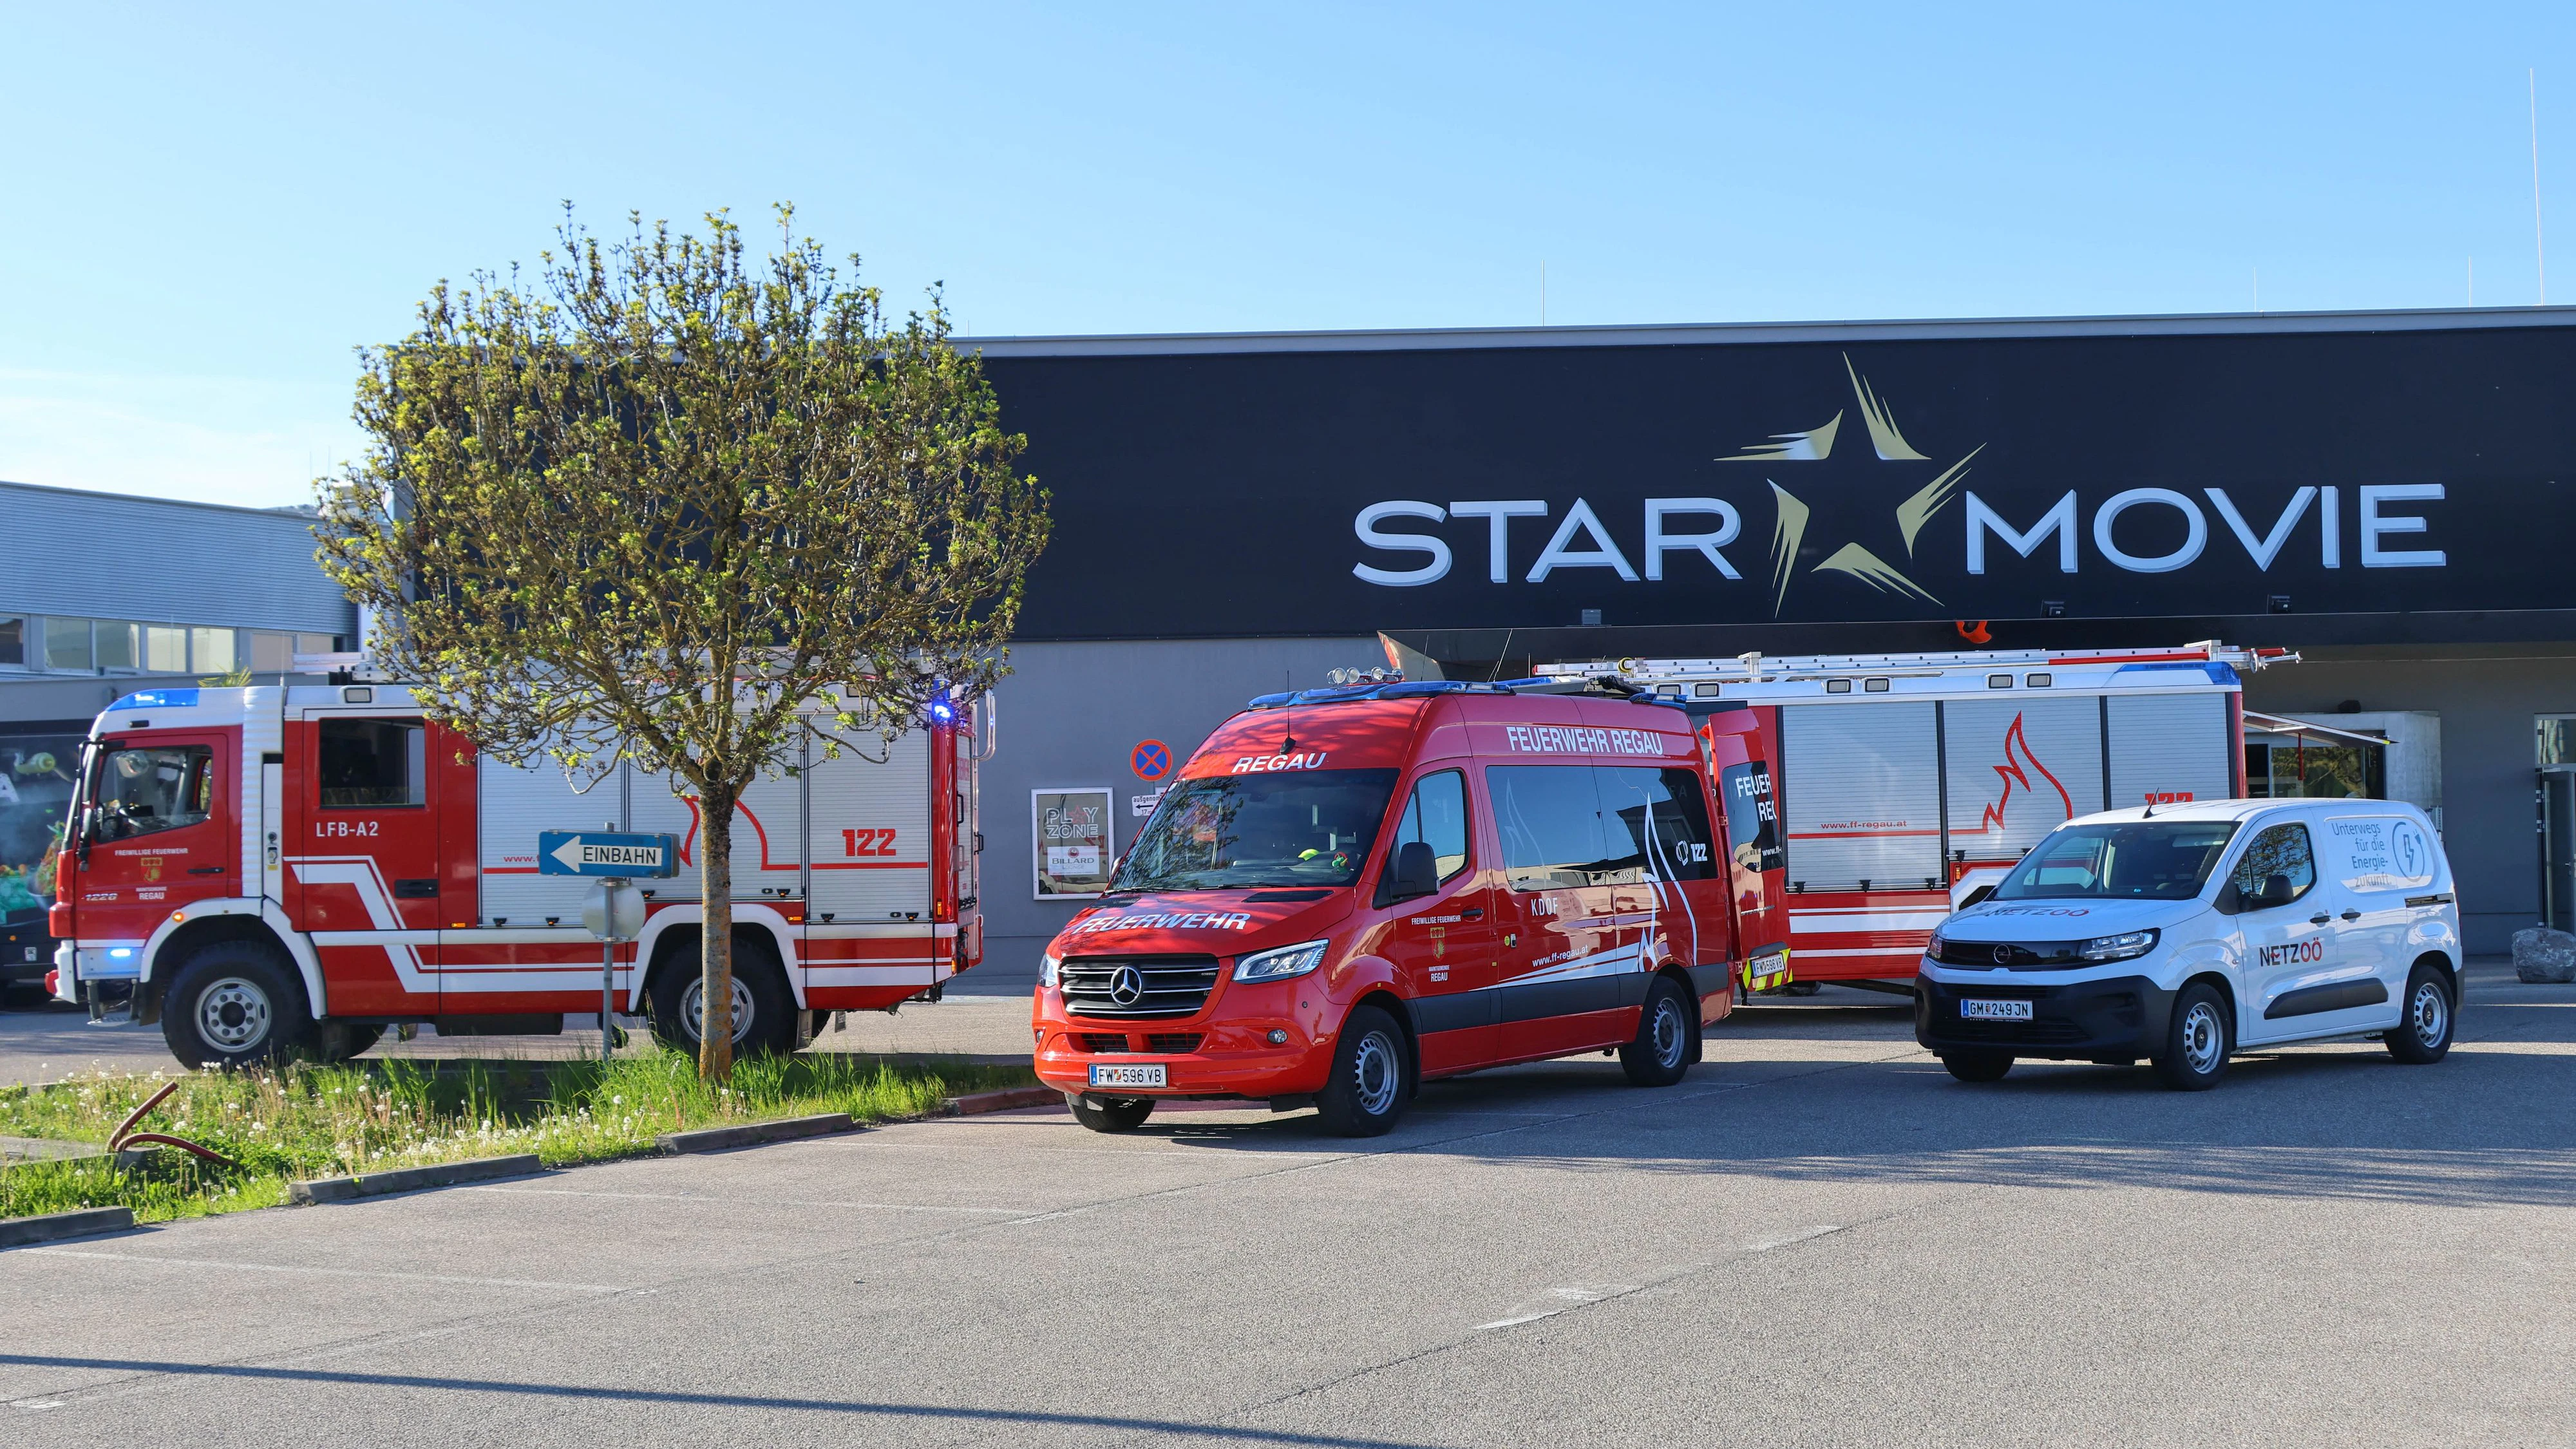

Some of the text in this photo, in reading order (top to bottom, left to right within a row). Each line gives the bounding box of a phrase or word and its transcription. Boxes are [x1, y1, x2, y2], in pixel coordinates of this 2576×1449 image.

[1352, 484, 2446, 586] STAR MOVIE
[1506, 726, 1663, 755] FEUERWEHR REGAU
[1231, 752, 1327, 773] REGAU
[316, 821, 379, 837] LFB-A2
[1046, 824, 1099, 838] ZONE
[1821, 820, 1907, 829] www.ff-regau.at
[2331, 822, 2381, 837] Unterwegs
[842, 828, 896, 857] 122
[2355, 837, 2385, 851] für die
[583, 846, 656, 864] EINBAHN
[1690, 843, 1708, 862] 122
[2351, 854, 2388, 871] Energie-
[2354, 871, 2392, 887] zukunft.
[138, 892, 165, 900] REGAU
[1531, 897, 1558, 916] KDOF
[1072, 913, 1251, 934] FEUERWEHR
[1412, 915, 1461, 925] FREIWILLIGE FEUERWEHR
[1532, 945, 1589, 967] www.ff-regau.at
[2259, 937, 2322, 967] NETZOÖ
[1766, 958, 1776, 971] 596
[1431, 972, 1448, 983] REGAU
[1971, 1003, 1984, 1015] GM
[1992, 1003, 2012, 1016] 249
[2015, 1004, 2028, 1016] JN
[1099, 1069, 1113, 1083] FW
[1122, 1069, 1144, 1083] 596
[1147, 1069, 1160, 1083] VB
